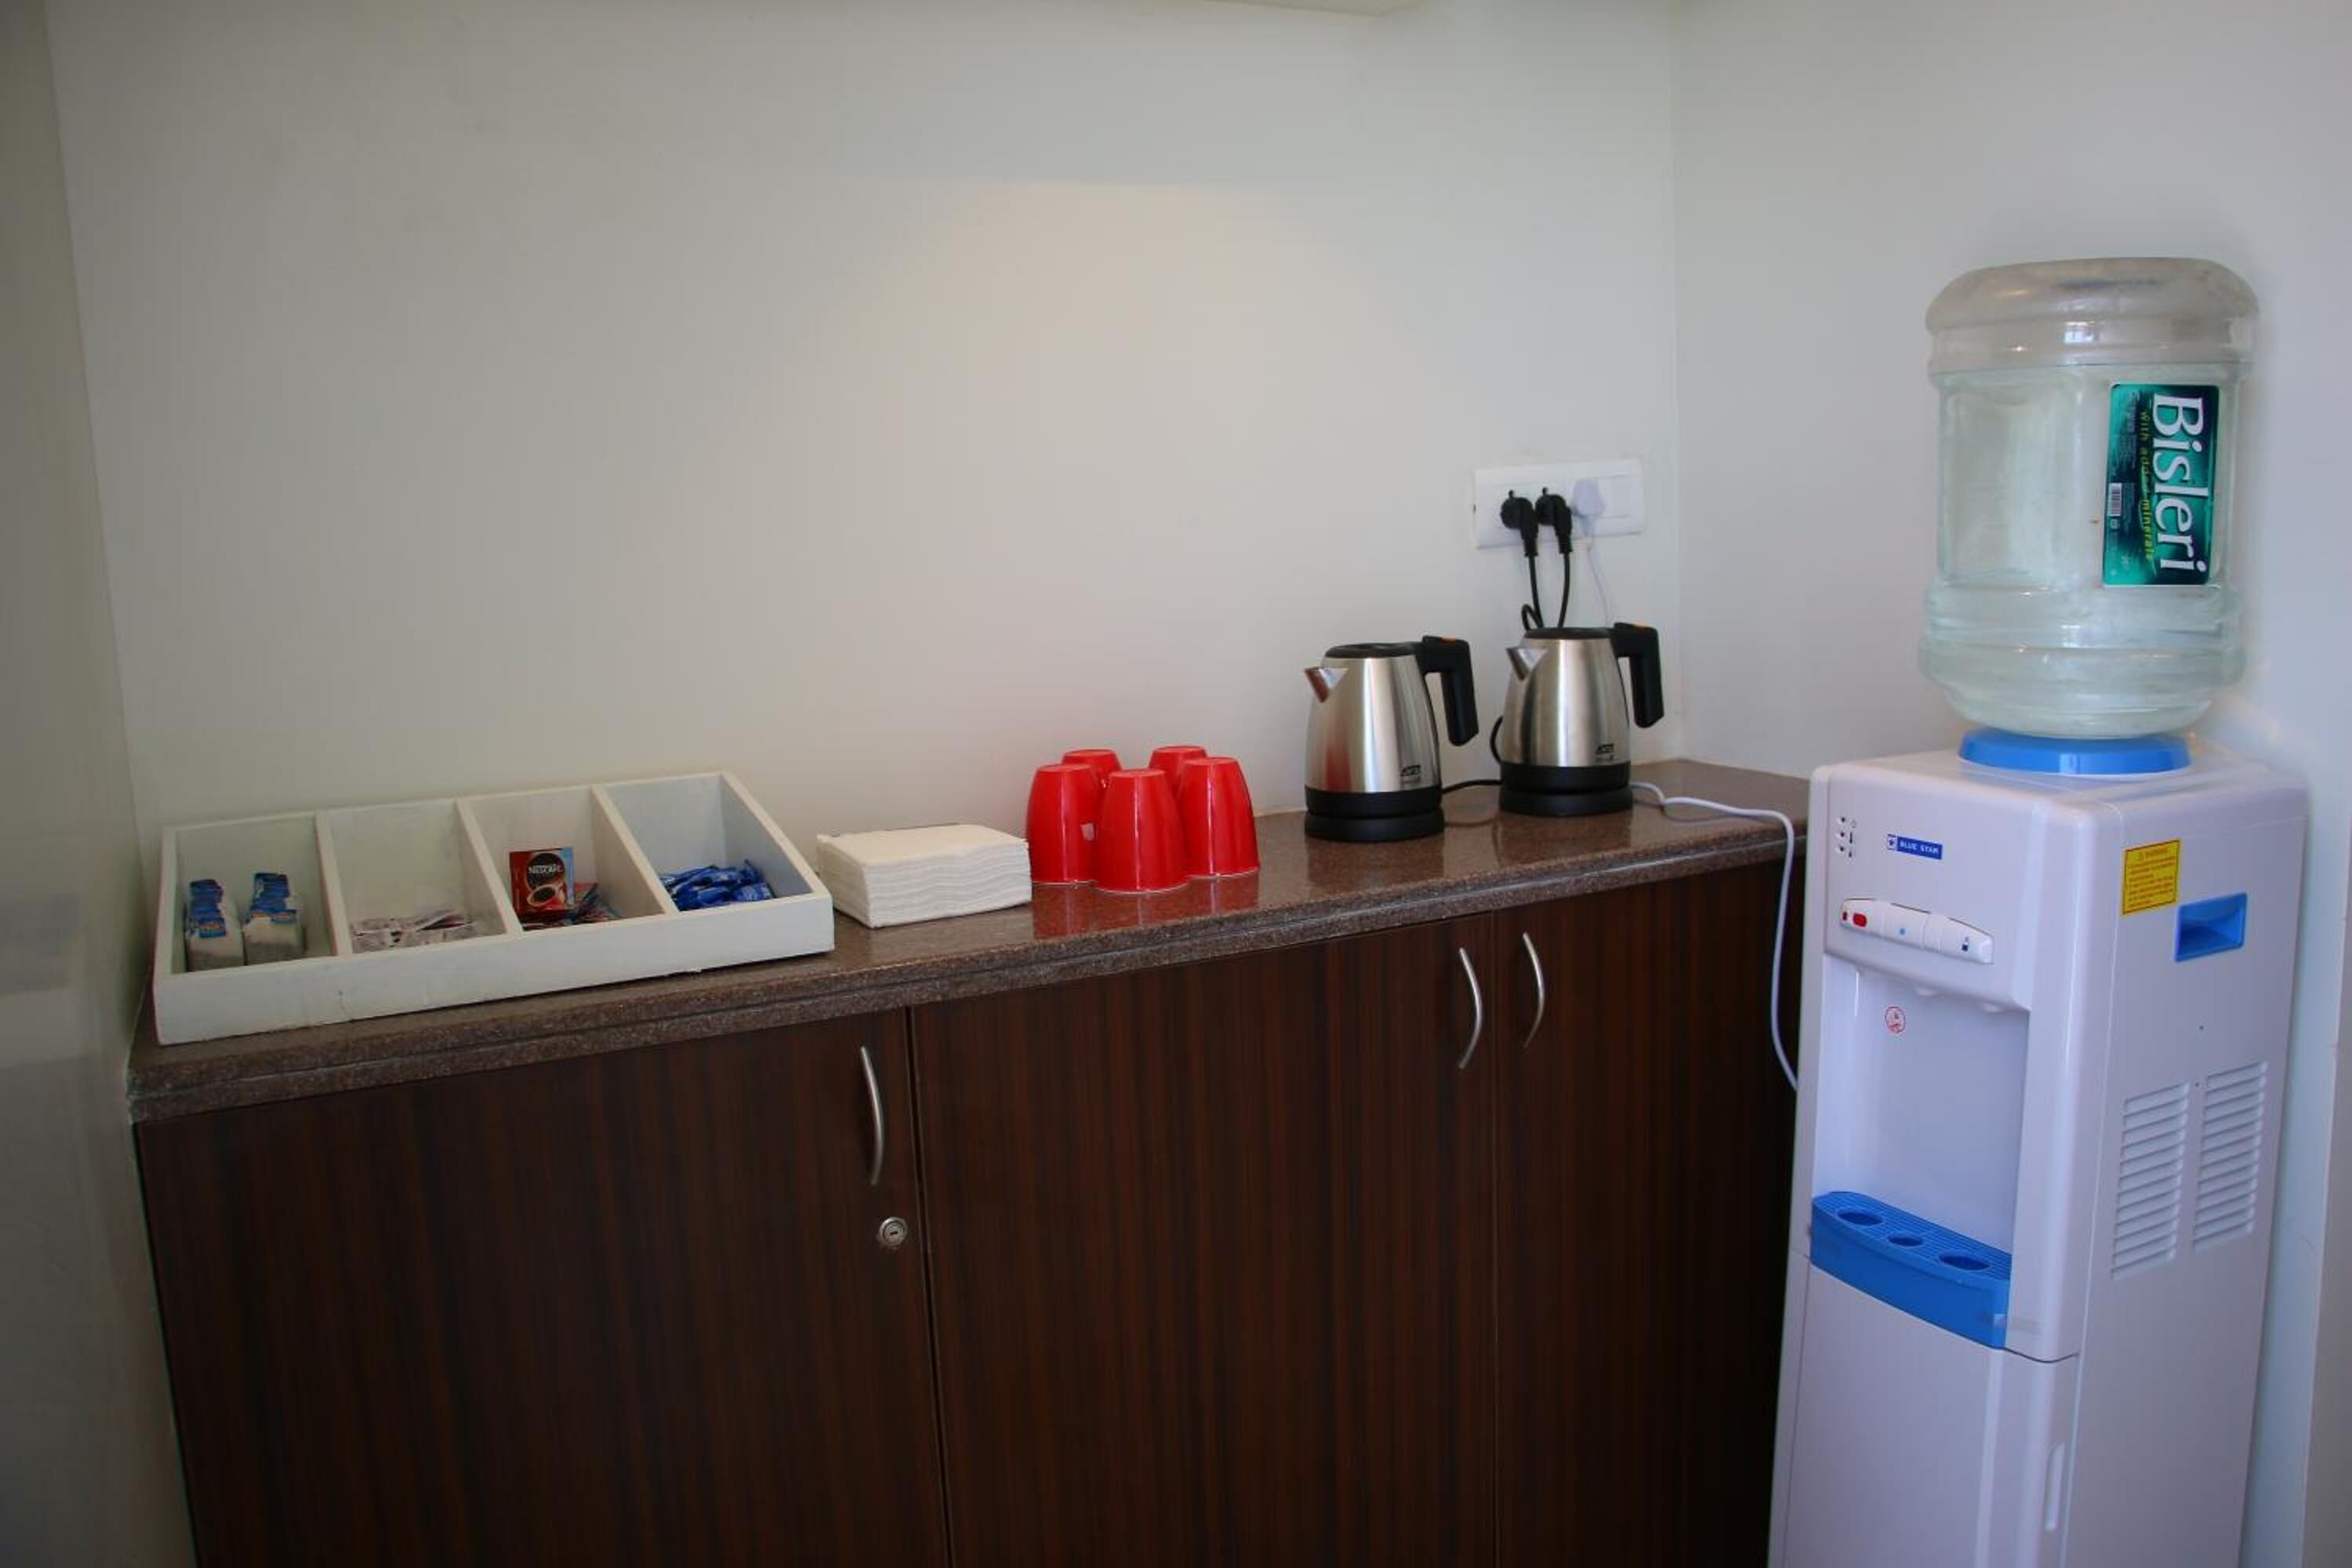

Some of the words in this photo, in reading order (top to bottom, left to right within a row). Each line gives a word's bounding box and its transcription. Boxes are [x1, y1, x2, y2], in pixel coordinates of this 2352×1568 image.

[2153, 394, 2208, 572] Bisleri
[1900, 840, 1917, 851] BLUE
[1920, 844, 1939, 854] STAR
